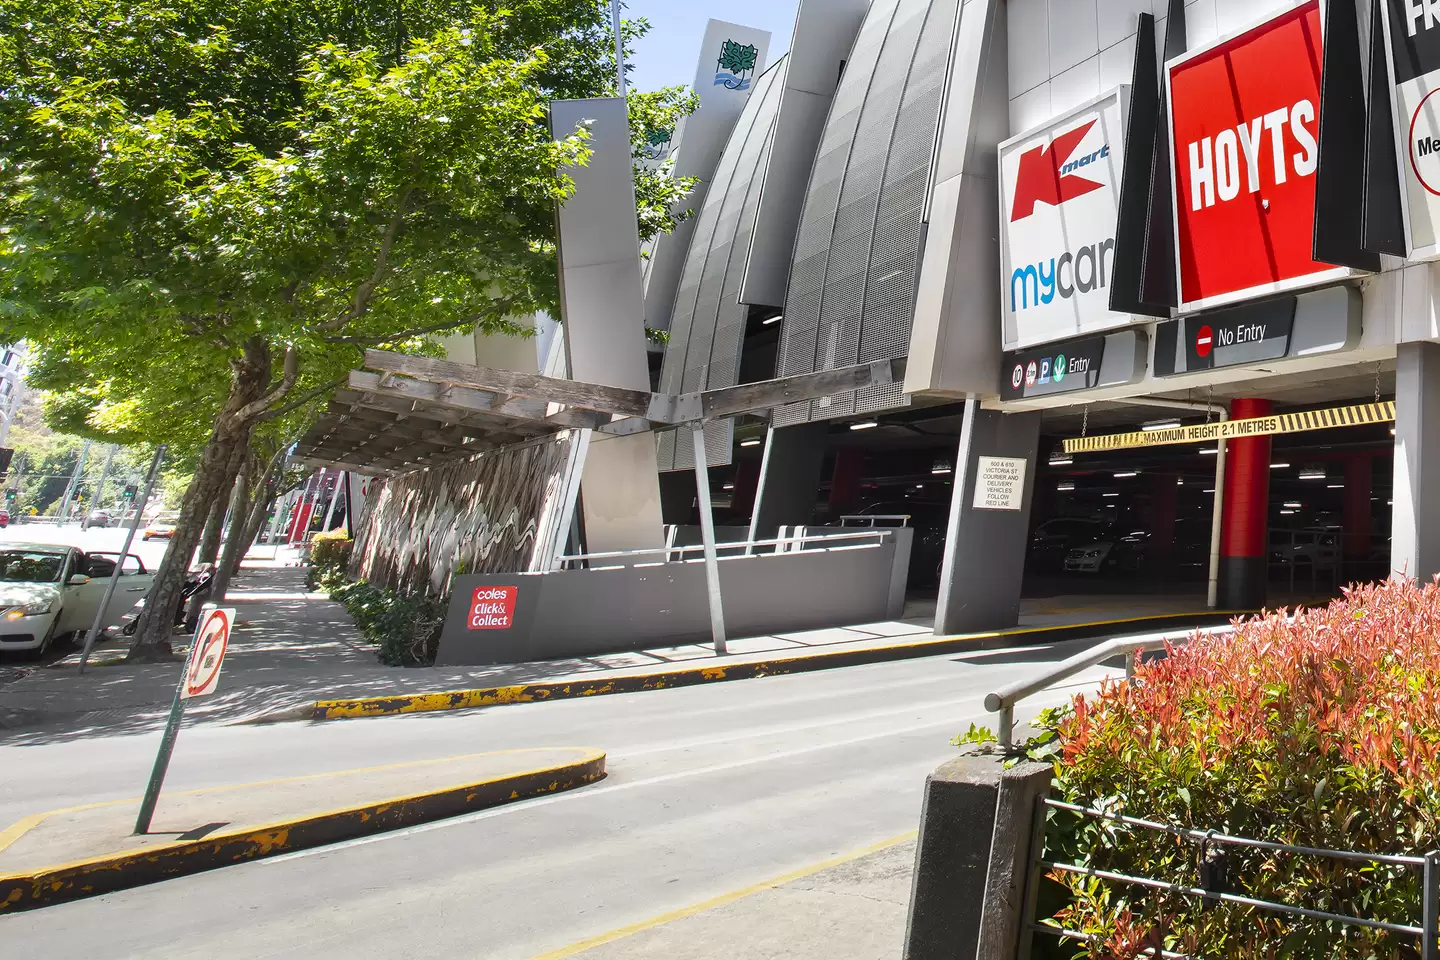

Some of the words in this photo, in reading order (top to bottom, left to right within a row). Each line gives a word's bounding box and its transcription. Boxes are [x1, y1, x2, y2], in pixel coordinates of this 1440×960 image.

[1188, 98, 1318, 211] HOYTS
[1011, 237, 1115, 313] mycar
[1218, 328, 1234, 346] No
[1237, 323, 1266, 343] Entry
[1069, 357, 1091, 374] Entry
[1143, 429, 1186, 443] MAXIMUM
[1188, 425, 1219, 439] HEIGHT
[1221, 423, 1235, 436] 2.1
[1237, 419, 1277, 433] METRES
[477, 588, 507, 600] coles
[472, 614, 508, 626] Collect
